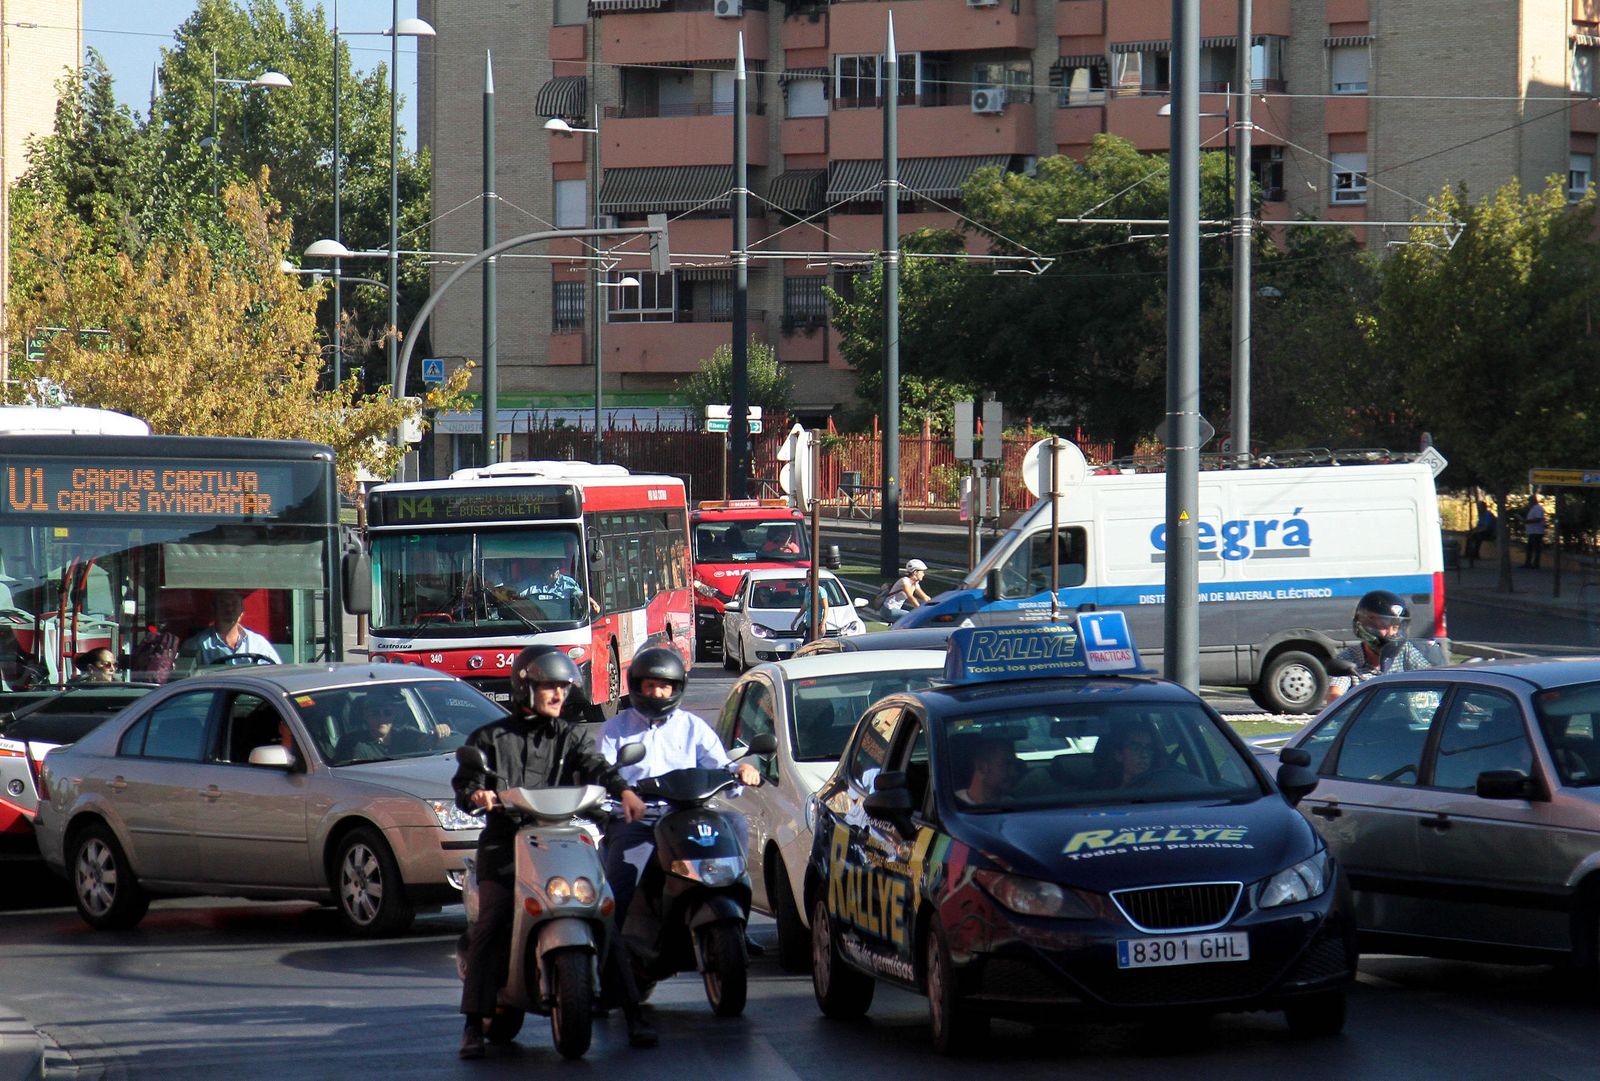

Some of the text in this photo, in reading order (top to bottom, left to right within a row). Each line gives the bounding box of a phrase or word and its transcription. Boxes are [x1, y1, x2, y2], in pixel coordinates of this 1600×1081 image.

[8, 467, 48, 511] U1
[73, 468, 258, 492] CAMPUS CARTUJA
[57, 490, 272, 514] CAMPUS AYNADAMAR
[398, 496, 435, 519] N4
[1210, 591, 1225, 602] DE
[1226, 589, 1274, 601] MATERIAL
[1276, 587, 1332, 599] ELÉCTRICO
[998, 626, 1074, 636] autoescuelas
[1090, 619, 1117, 646] L
[966, 630, 1078, 663] RALLYE
[1089, 650, 1131, 662] PRACTICAS
[430, 653, 514, 668] 340 34
[968, 666, 1005, 674] Todos
[1030, 660, 1085, 672] permisos
[1062, 829, 1249, 853] RALLYE
[1118, 825, 1164, 833] AUTO
[1067, 841, 1254, 861] Todos los permisos
[828, 823, 906, 945] RALLYE
[1133, 940, 1189, 963] 8301
[1200, 937, 1242, 959] GHL
[872, 953, 914, 981] permisos
